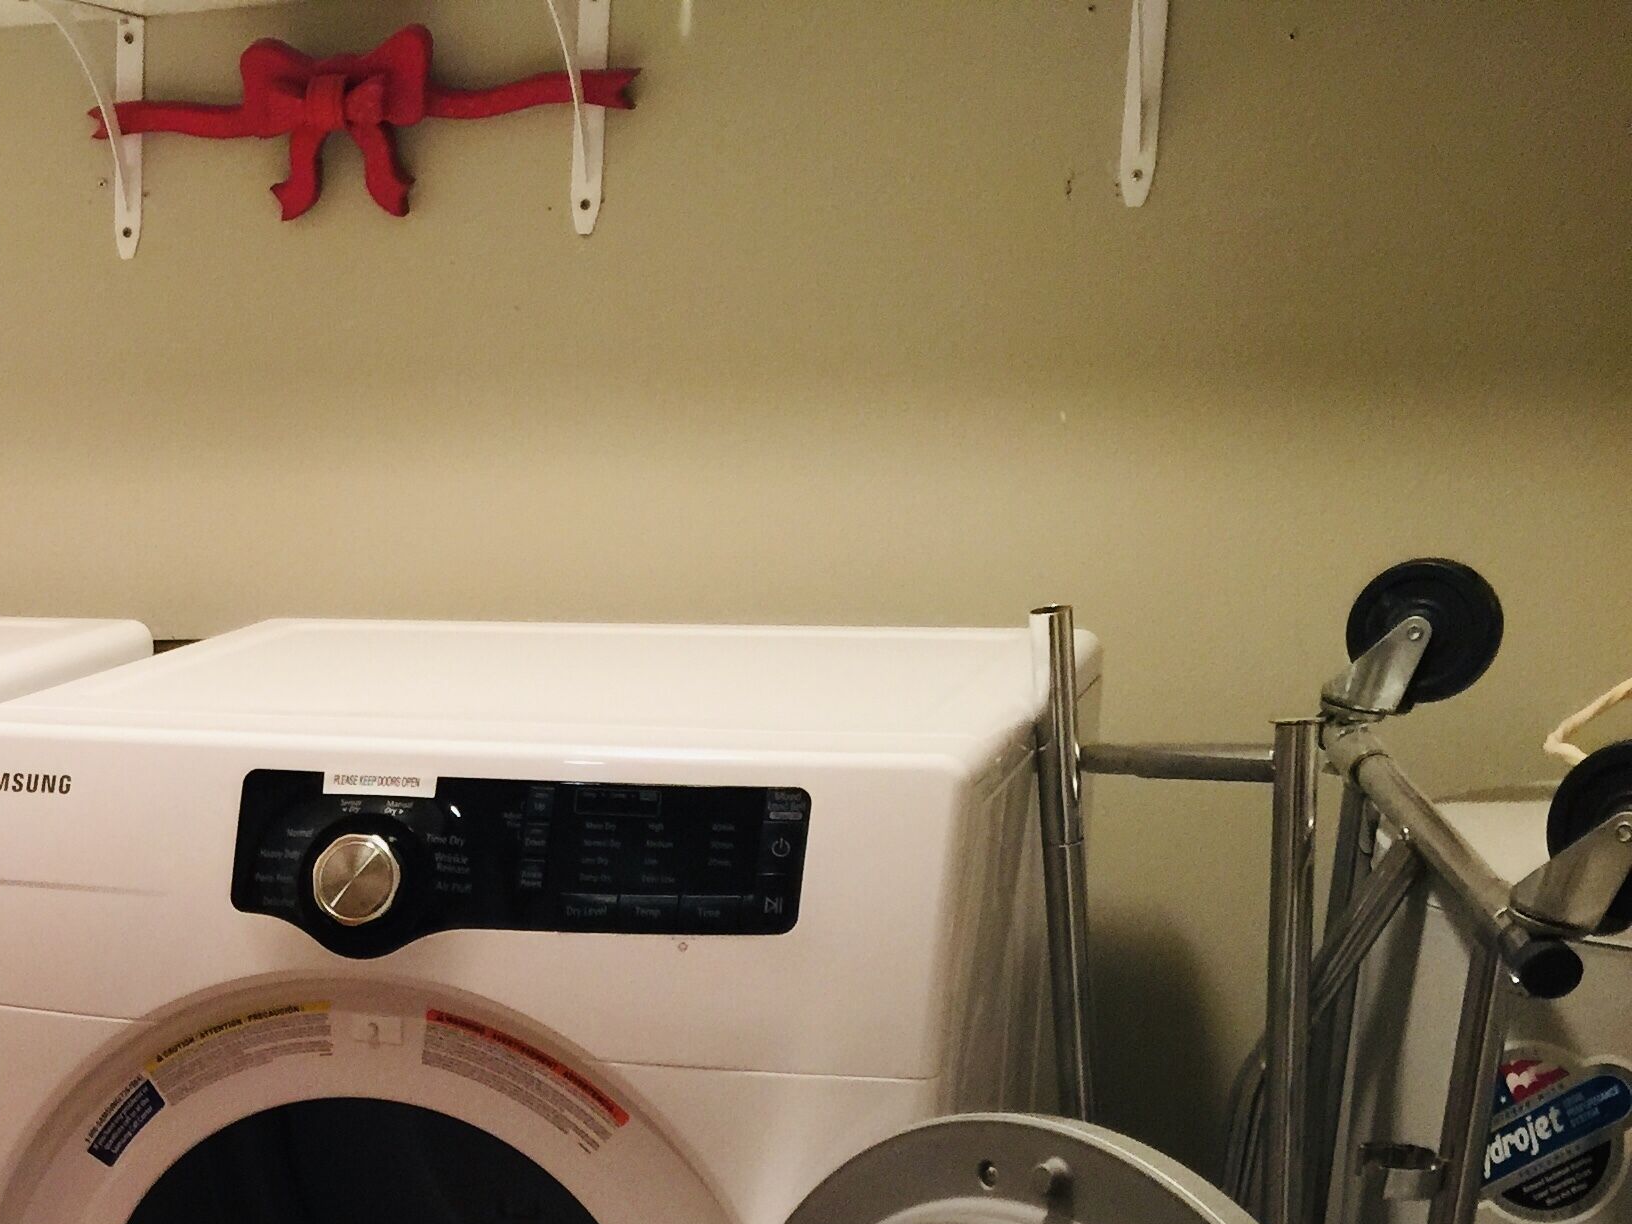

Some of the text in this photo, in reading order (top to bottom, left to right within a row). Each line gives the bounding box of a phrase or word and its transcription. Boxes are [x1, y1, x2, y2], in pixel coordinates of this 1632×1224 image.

[334, 775, 420, 788] PLEASE KEEP DOORS OPEN
